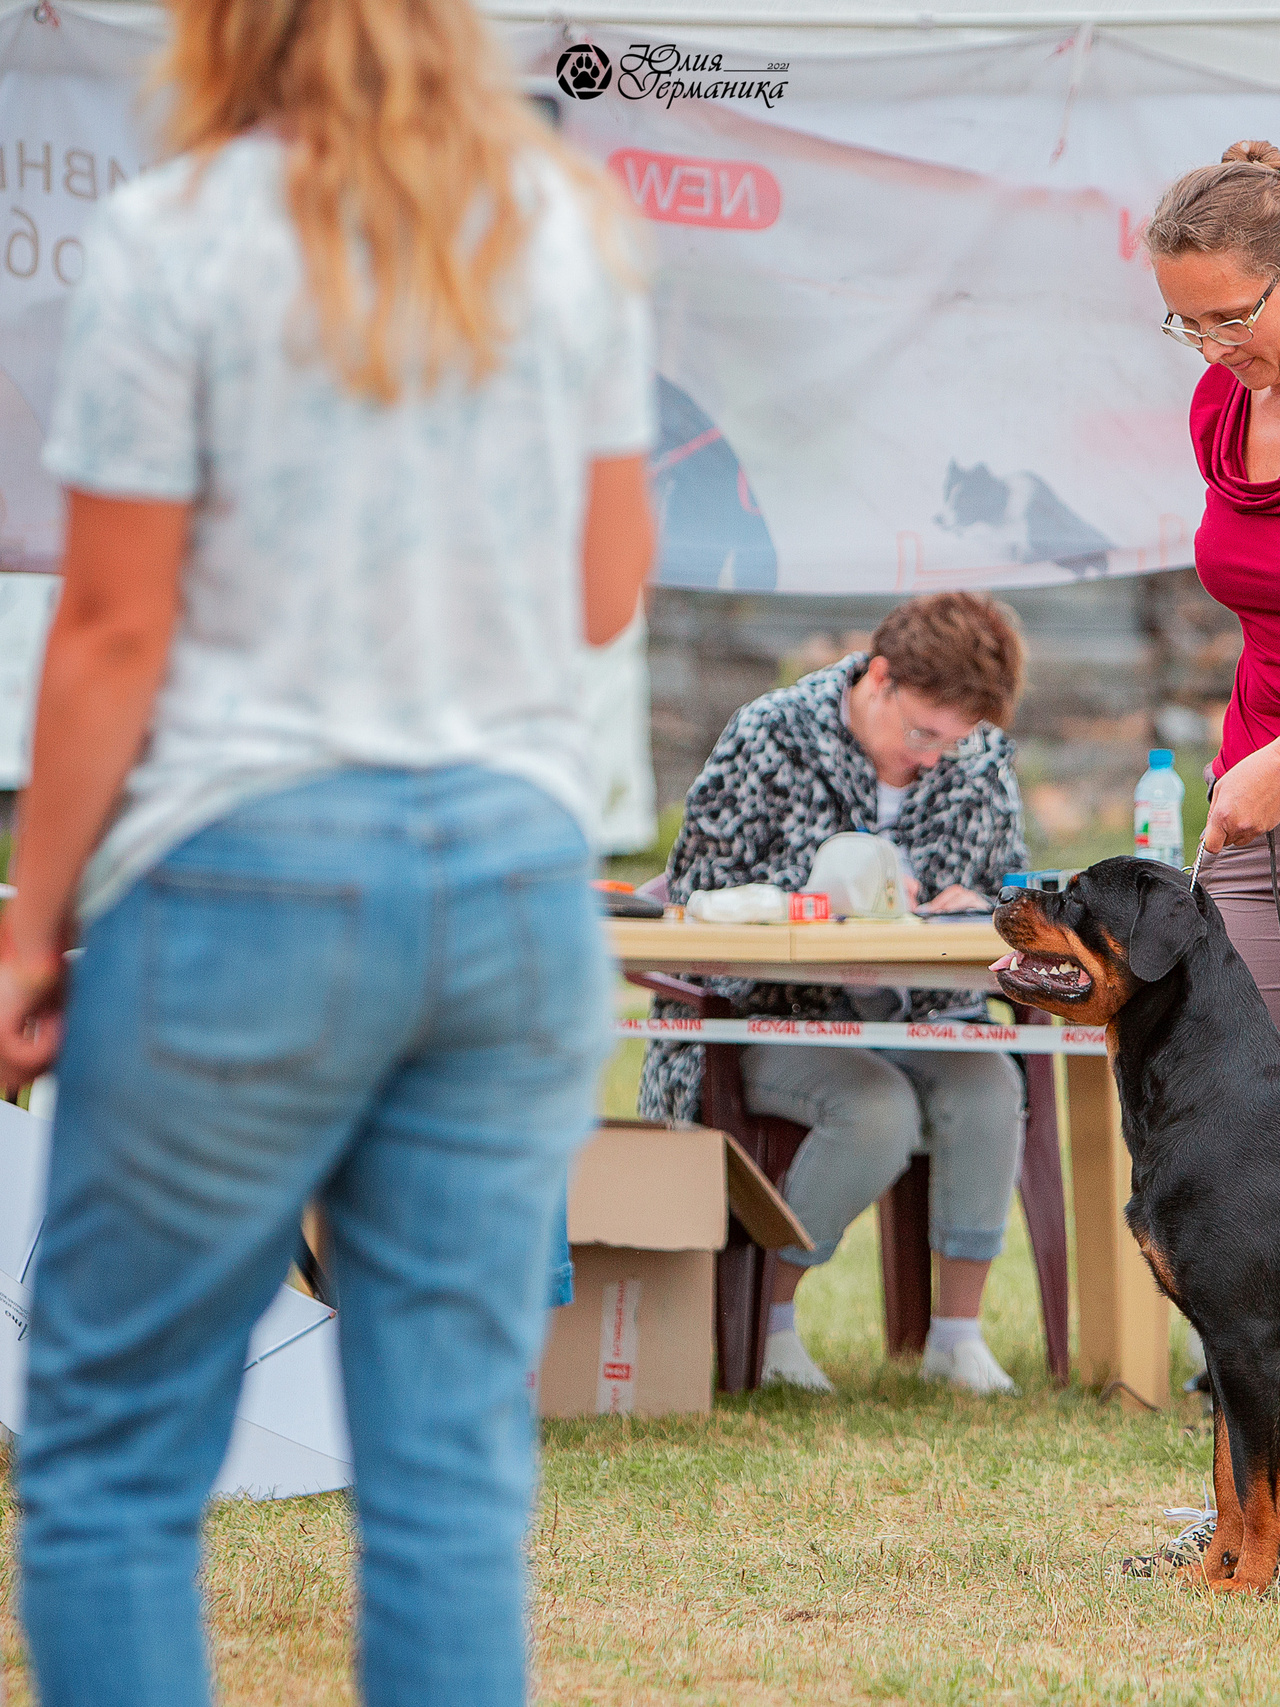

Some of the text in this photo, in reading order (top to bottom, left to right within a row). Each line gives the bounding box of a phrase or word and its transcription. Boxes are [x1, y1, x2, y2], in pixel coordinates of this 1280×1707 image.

[646, 1018, 703, 1032] CANIN
[747, 1019, 862, 1036] ROYAL CANIN
[907, 1023, 1018, 1042] ROYAL CANIN
